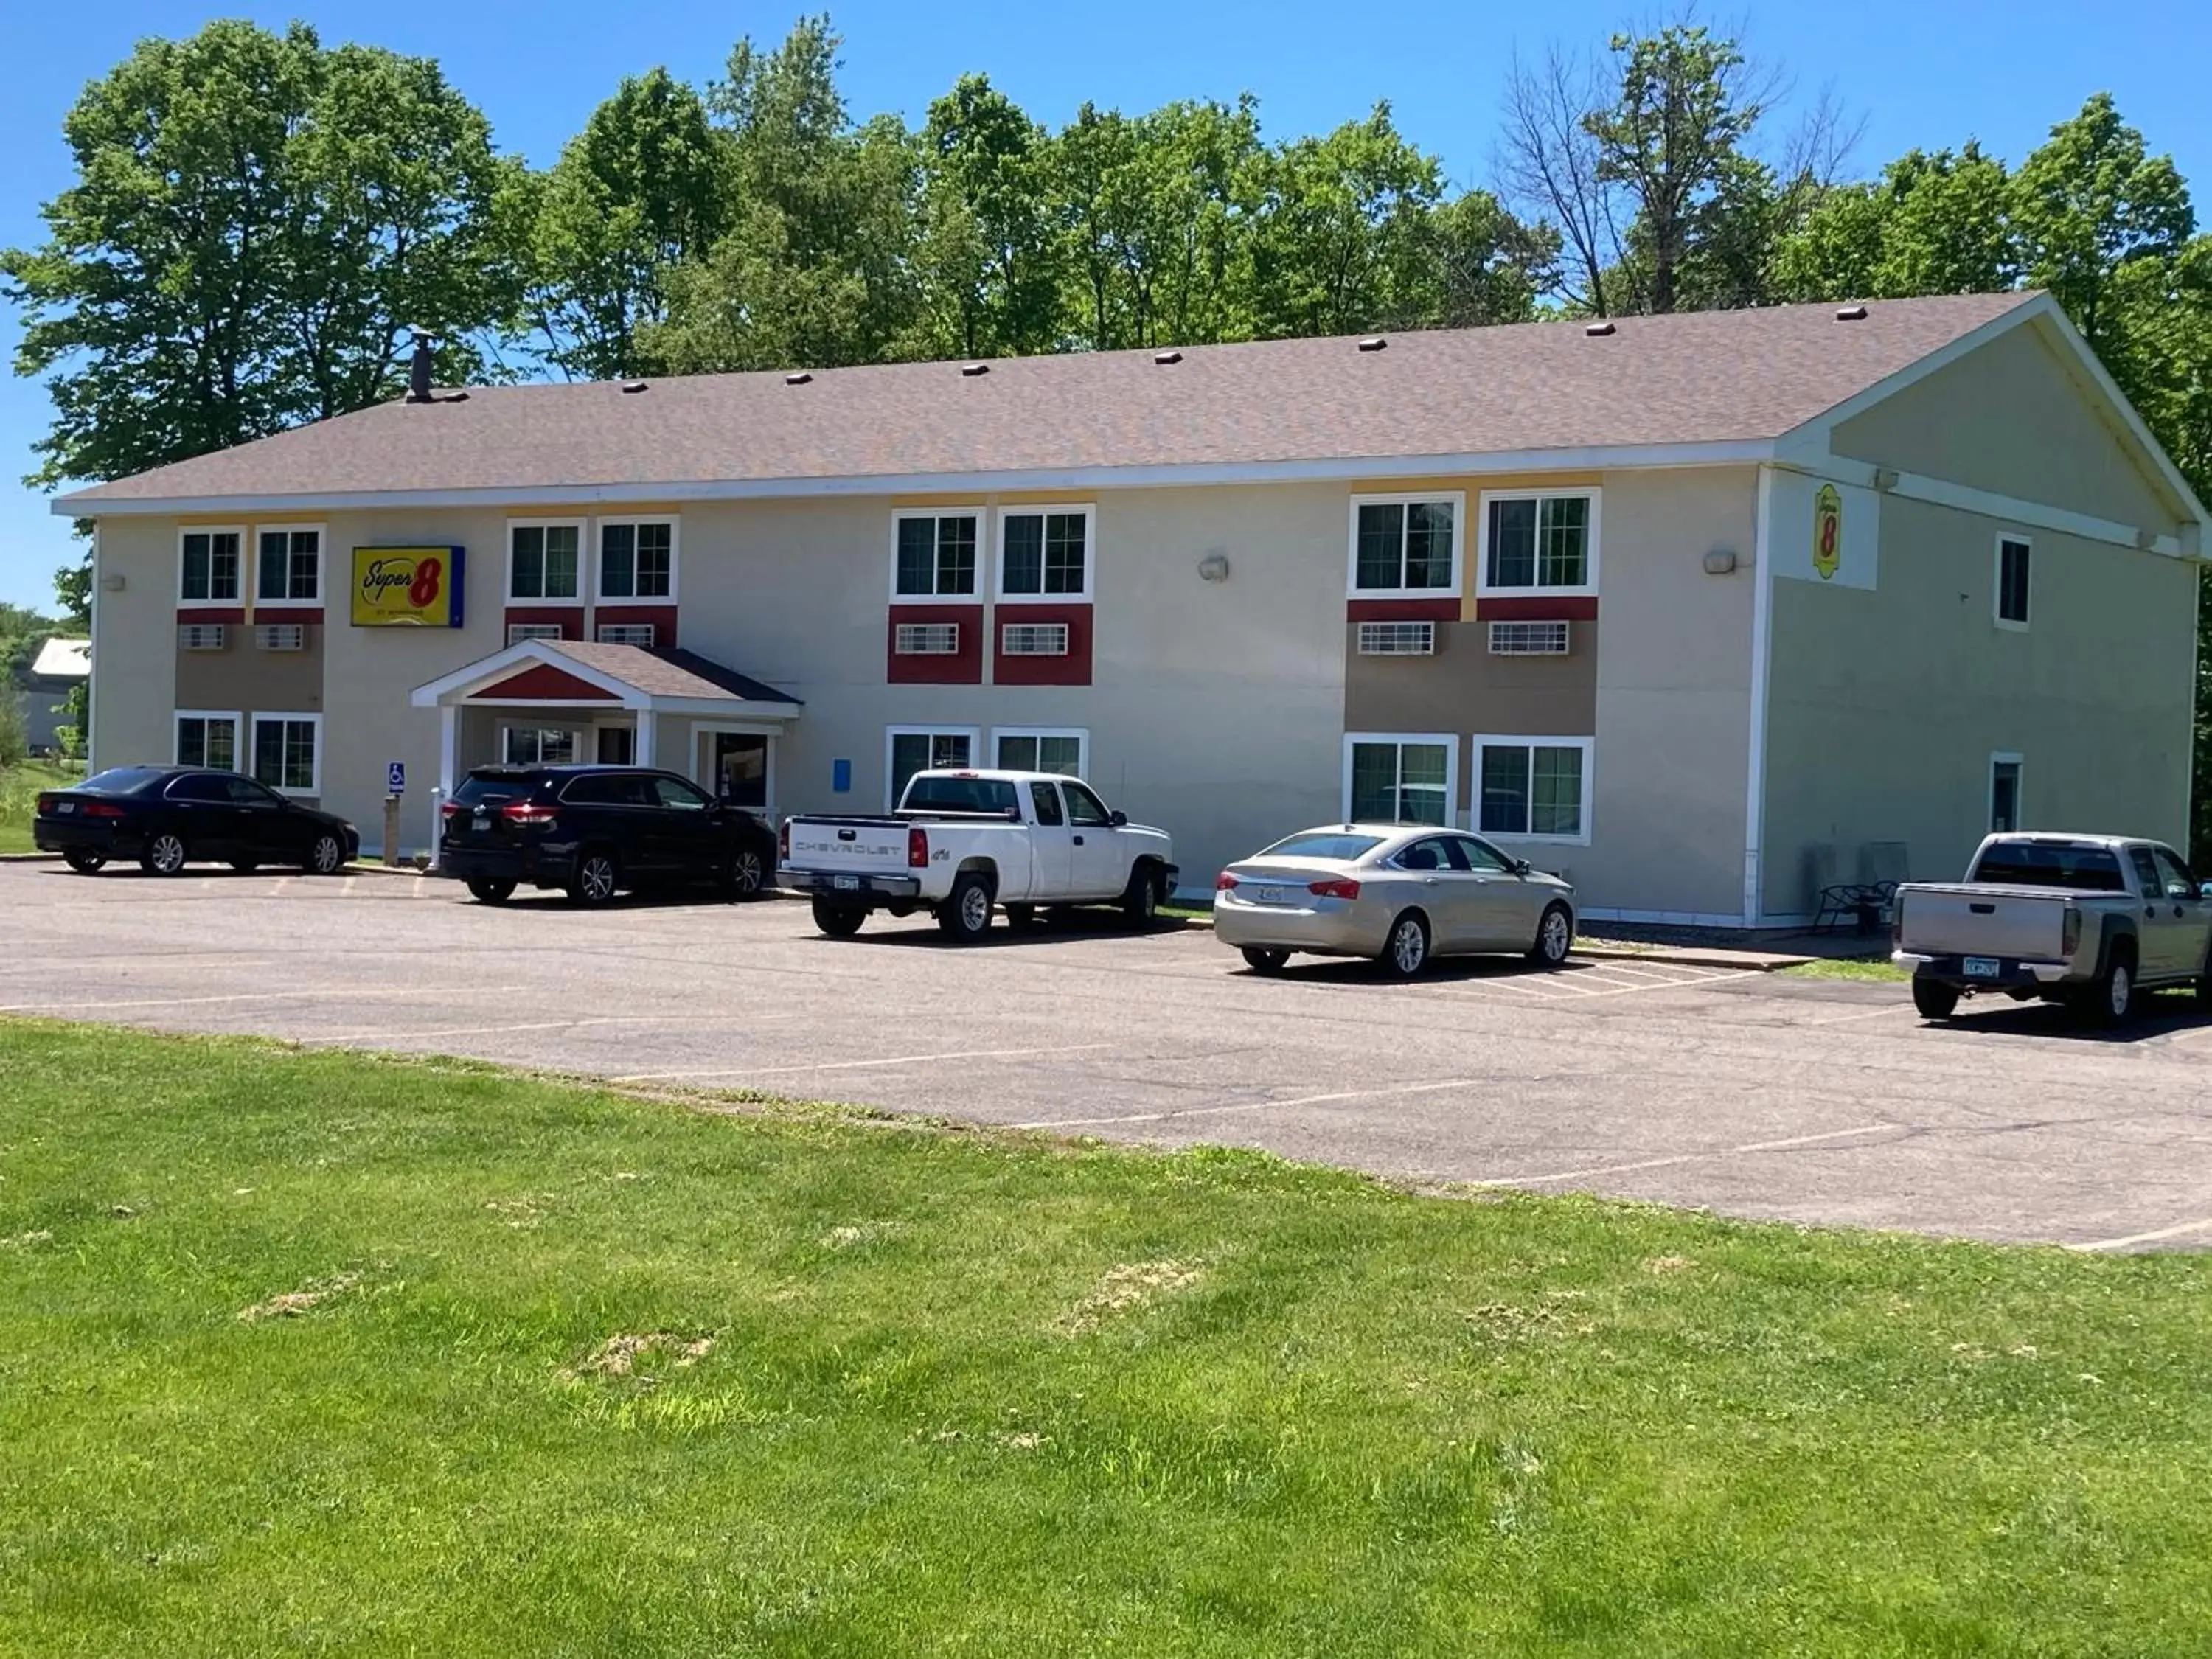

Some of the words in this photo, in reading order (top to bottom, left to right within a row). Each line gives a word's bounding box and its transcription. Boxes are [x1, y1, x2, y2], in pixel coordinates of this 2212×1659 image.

[1820, 515, 1837, 558] 8
[363, 560, 414, 602] Super
[408, 557, 442, 608] 8
[795, 841, 902, 856] CHEVROLET
